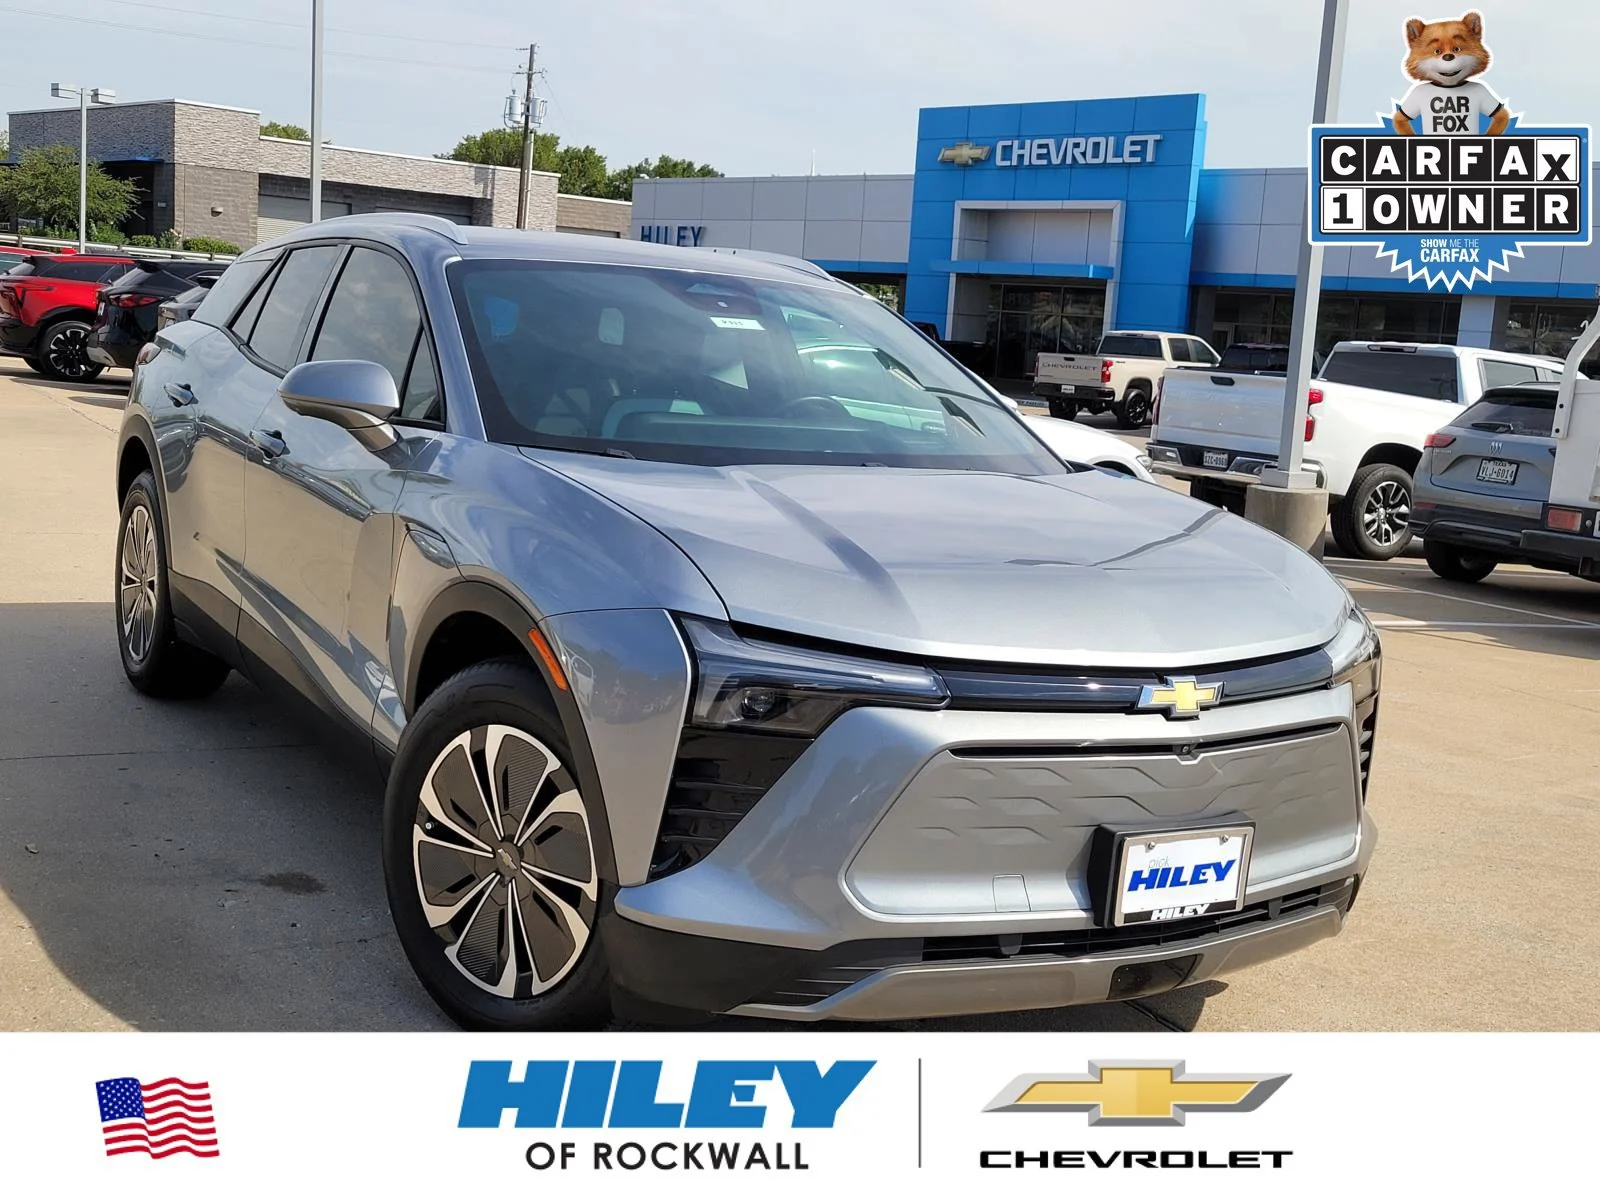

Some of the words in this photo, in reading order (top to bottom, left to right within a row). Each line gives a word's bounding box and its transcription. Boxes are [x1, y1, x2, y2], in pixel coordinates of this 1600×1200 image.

[995, 134, 1163, 167] CHEVROLET
[641, 226, 703, 247] HILEY
[1127, 859, 1236, 892] HILEY
[1152, 903, 1210, 920] HILEY
